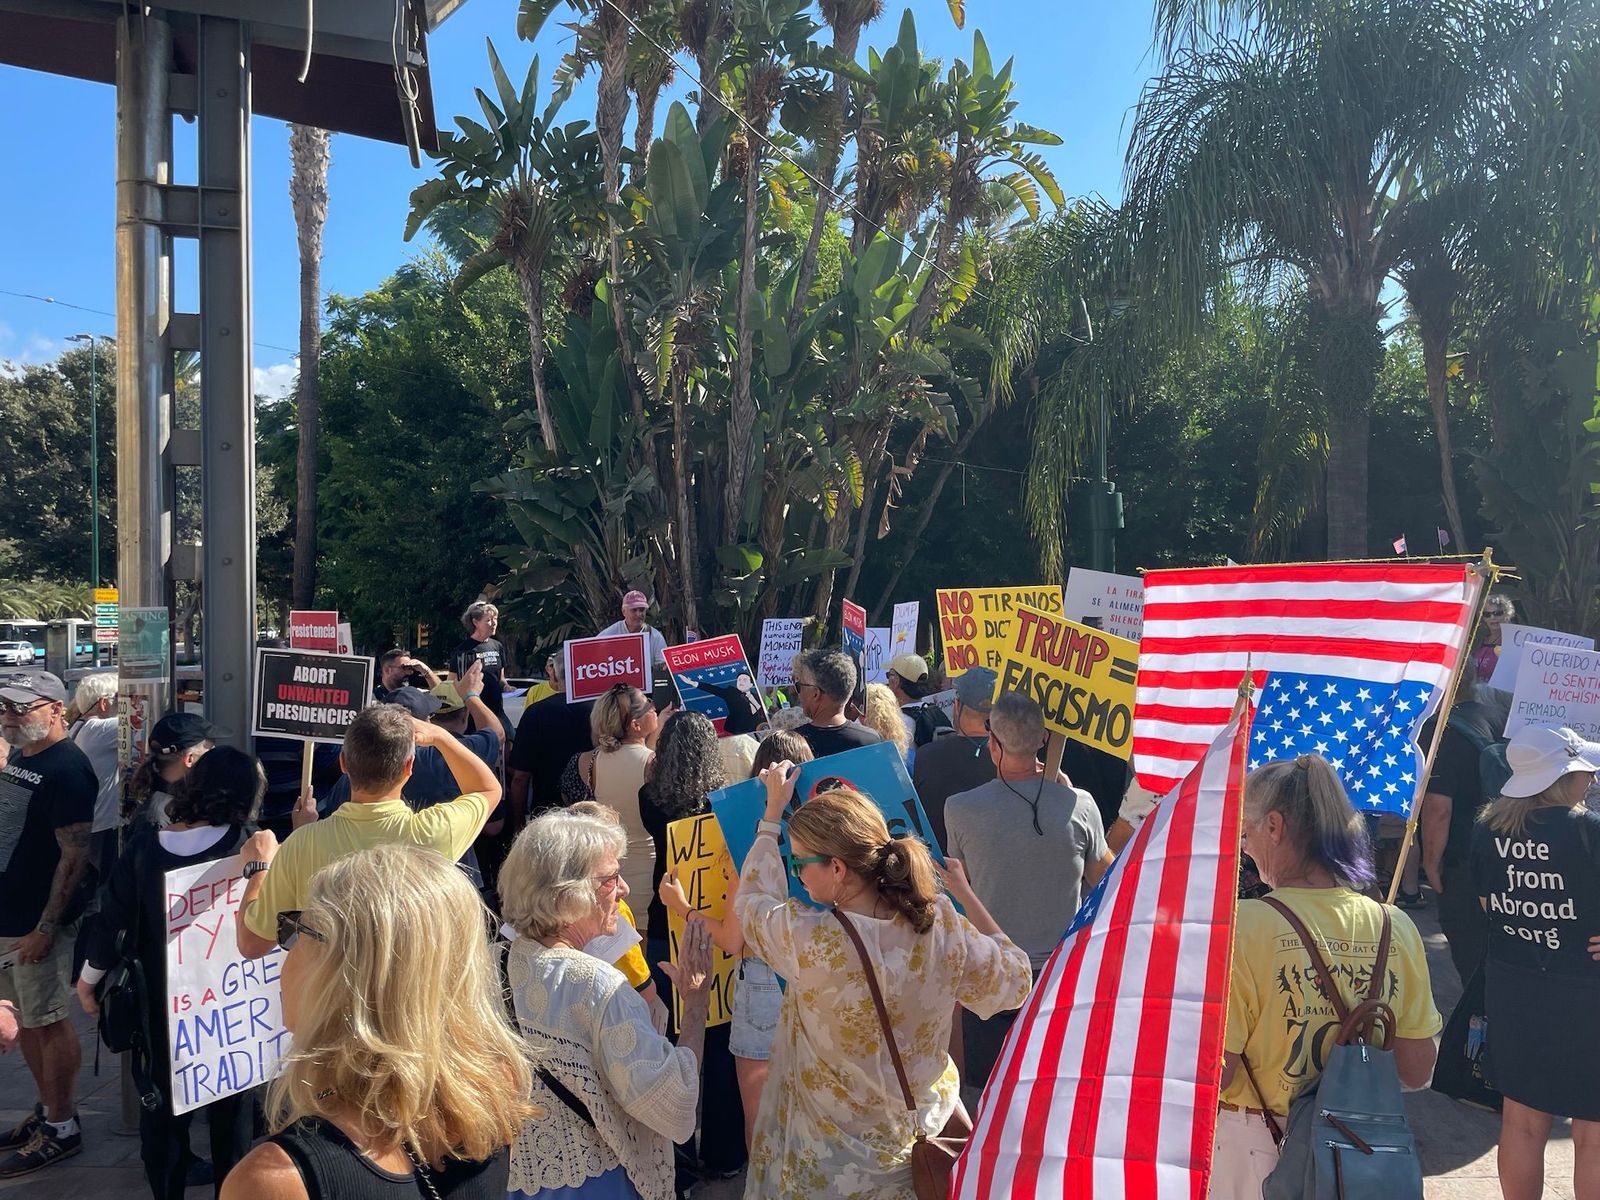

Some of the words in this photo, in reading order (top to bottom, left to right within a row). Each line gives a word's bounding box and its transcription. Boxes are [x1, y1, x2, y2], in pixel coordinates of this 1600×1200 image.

[1092, 597, 1101, 607] SE
[1106, 586, 1117, 595] LA
[938, 591, 974, 616] NO
[979, 591, 1062, 613] TIRANOS
[292, 623, 336, 639] resistencia
[941, 615, 978, 641] NO
[672, 652, 700, 667] ELON
[703, 645, 737, 661] MUSK
[764, 640, 801, 652] MOMENT
[1015, 609, 1110, 680] TRUMP
[576, 655, 641, 681] resist.
[947, 644, 979, 671] NO
[1531, 649, 1590, 672] QUERIDO
[293, 665, 337, 685] ABORT
[1543, 672, 1559, 685] LO
[277, 683, 349, 706] UNWANTED
[1000, 658, 1132, 748] FASCISMO
[266, 702, 358, 726] PRESIDENCIES
[1518, 701, 1567, 719] FIRMADO,
[669, 814, 715, 865] WE
[1494, 837, 1549, 861] Vote
[1506, 864, 1565, 892] from
[1490, 892, 1578, 920] Abroad
[1281, 939, 1299, 948] THE
[173, 994, 192, 1014] IS
[201, 987, 217, 1006] A
[221, 948, 281, 997] GRE
[175, 1029, 289, 1106] TRADIT
